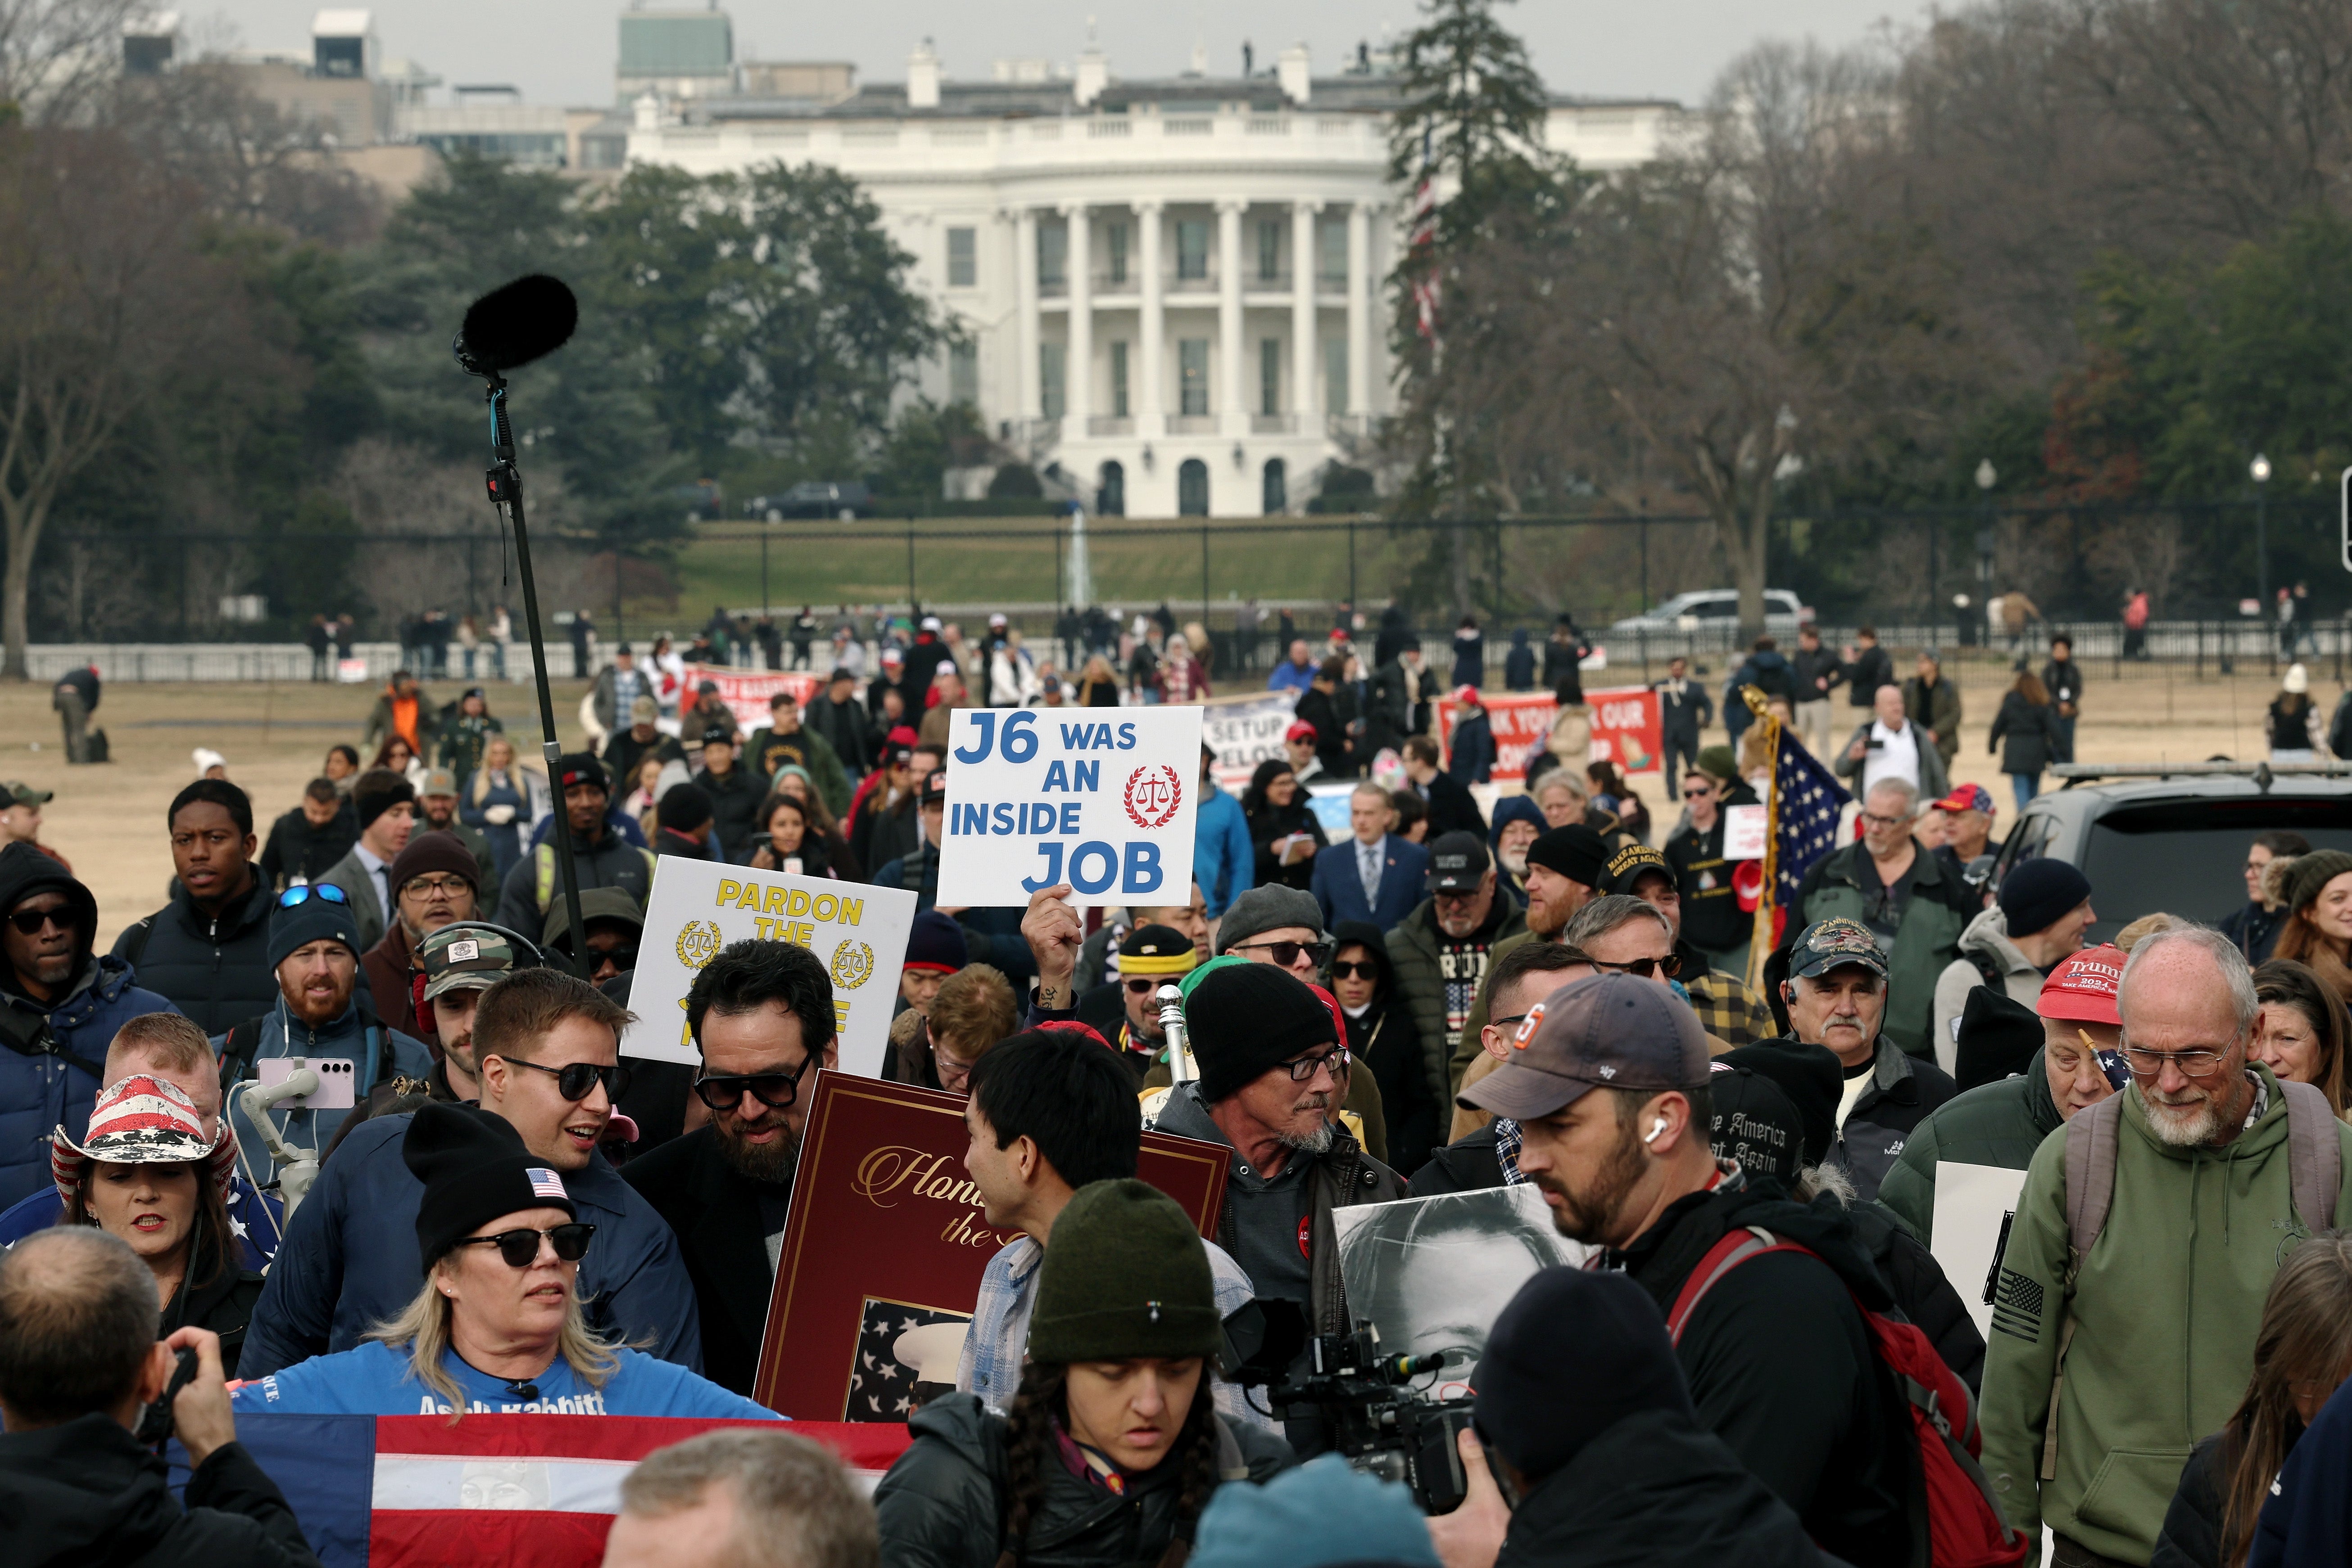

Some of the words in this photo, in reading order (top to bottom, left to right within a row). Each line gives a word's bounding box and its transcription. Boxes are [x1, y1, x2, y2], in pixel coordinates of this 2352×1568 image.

[1212, 716, 1283, 743] SETUP
[1601, 700, 1645, 729] OUR
[954, 711, 1038, 764] J6
[1060, 723, 1136, 750] WAS
[1042, 760, 1099, 792] AN
[951, 803, 1081, 835] INSIDE
[1021, 841, 1163, 895] JOB
[1607, 849, 1628, 871] MAKE
[1613, 856, 1638, 877] GREAT
[716, 878, 864, 926] PARDON
[754, 917, 814, 949] THE
[2080, 978, 2108, 988] 2024
[1728, 1112, 1786, 1148] America
[1735, 1142, 1776, 1173] Again
[941, 1212, 991, 1247] the
